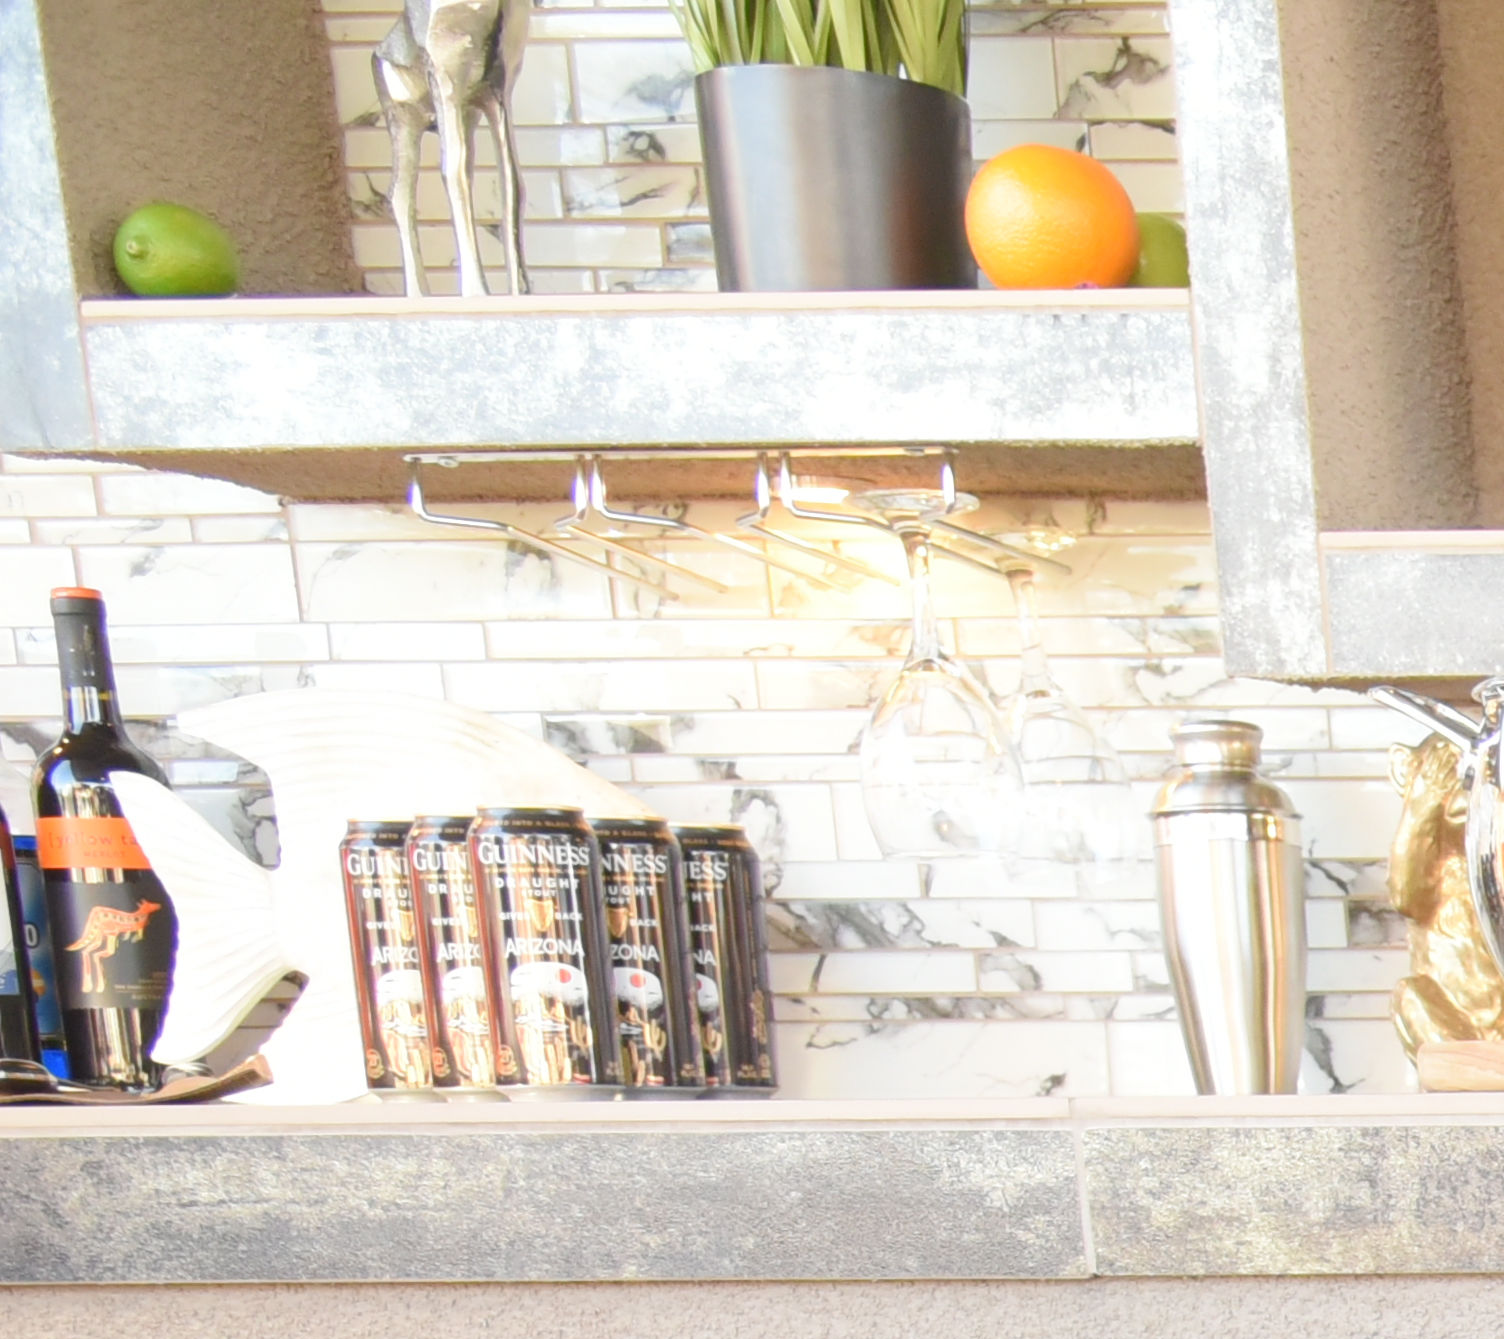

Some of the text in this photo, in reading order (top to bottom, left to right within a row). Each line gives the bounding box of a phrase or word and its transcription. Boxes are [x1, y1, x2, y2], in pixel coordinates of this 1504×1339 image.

[478, 841, 590, 866] GUINNESS
[494, 875, 580, 890] DRAUGHT
[504, 937, 586, 960] ARIZONA
